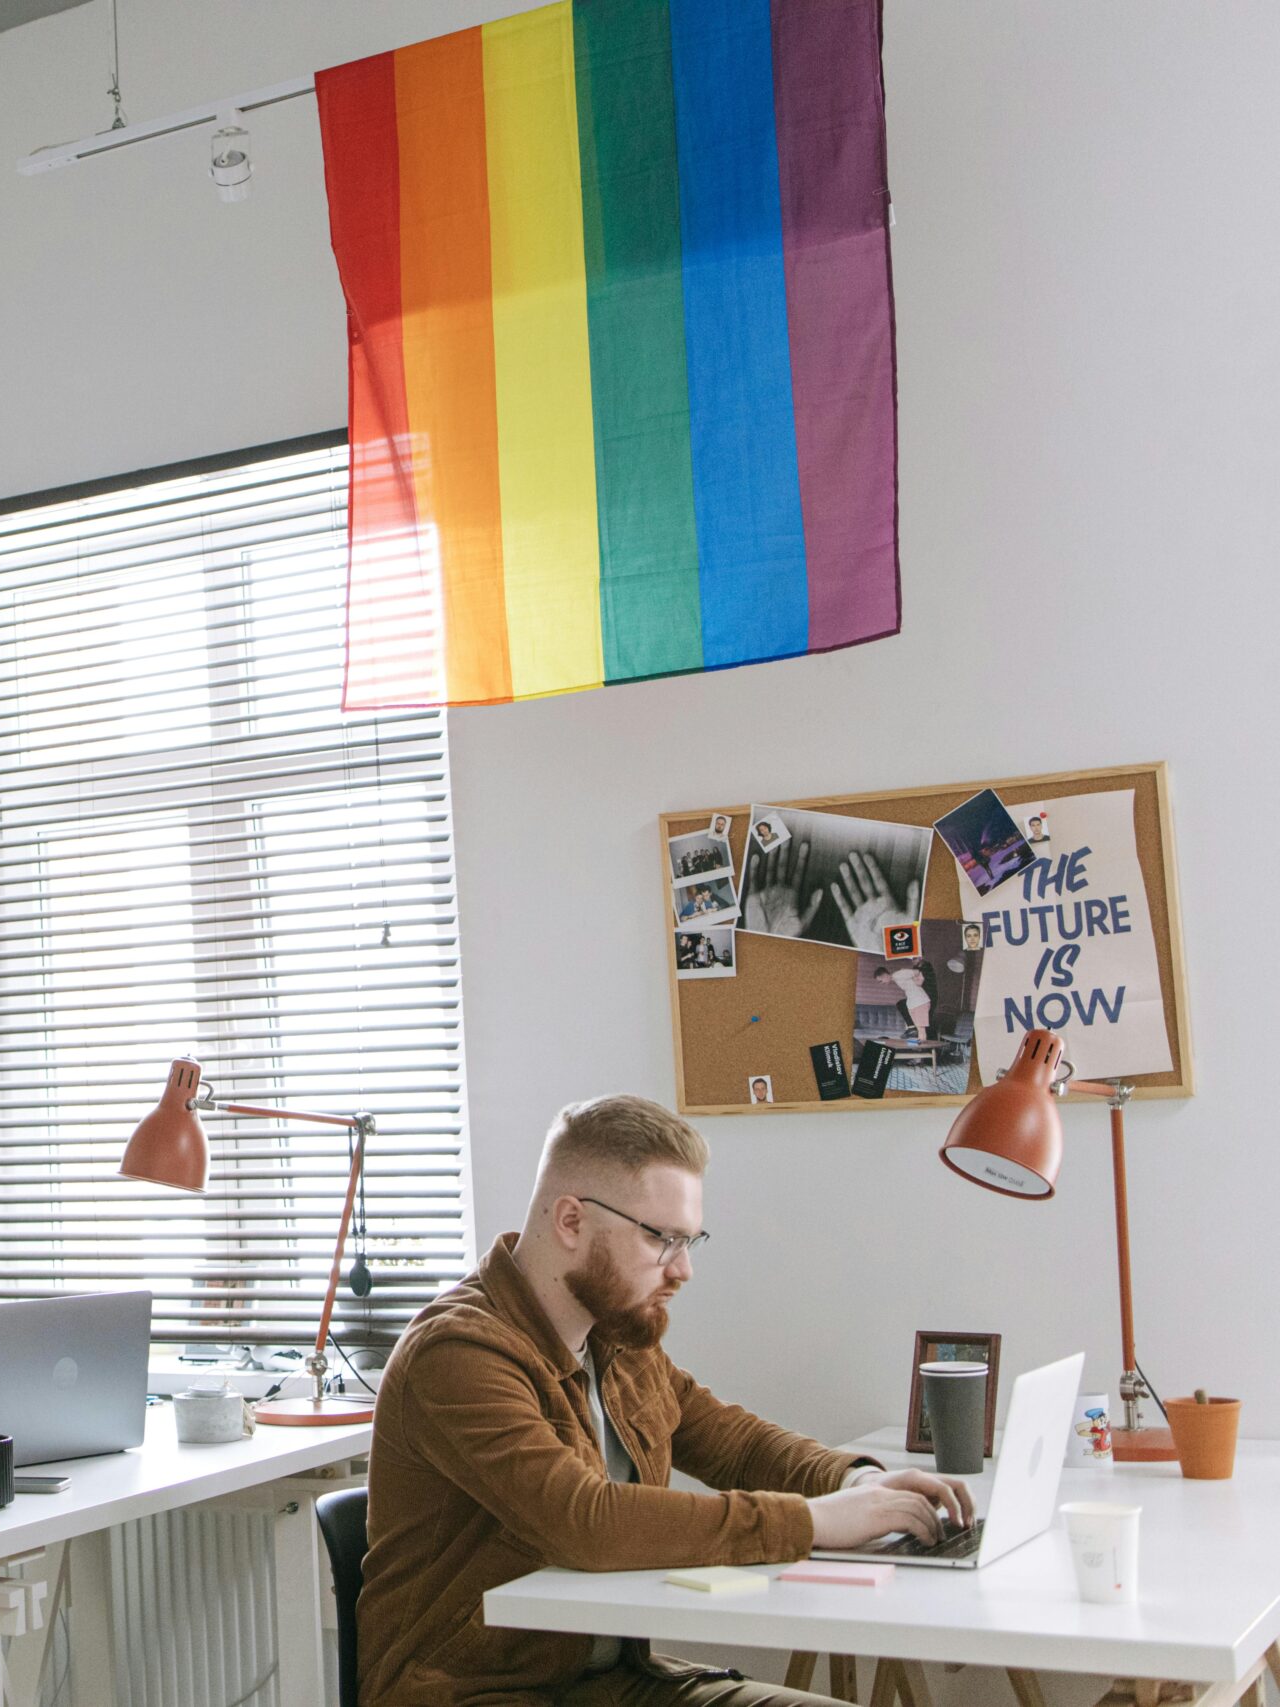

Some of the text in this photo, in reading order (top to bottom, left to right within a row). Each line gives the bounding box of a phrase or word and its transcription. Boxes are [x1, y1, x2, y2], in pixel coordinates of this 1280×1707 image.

[1018, 846, 1092, 903] THE
[981, 894, 1131, 948] FUTURE
[1033, 943, 1081, 990] IS
[1004, 985, 1126, 1033] NOW
